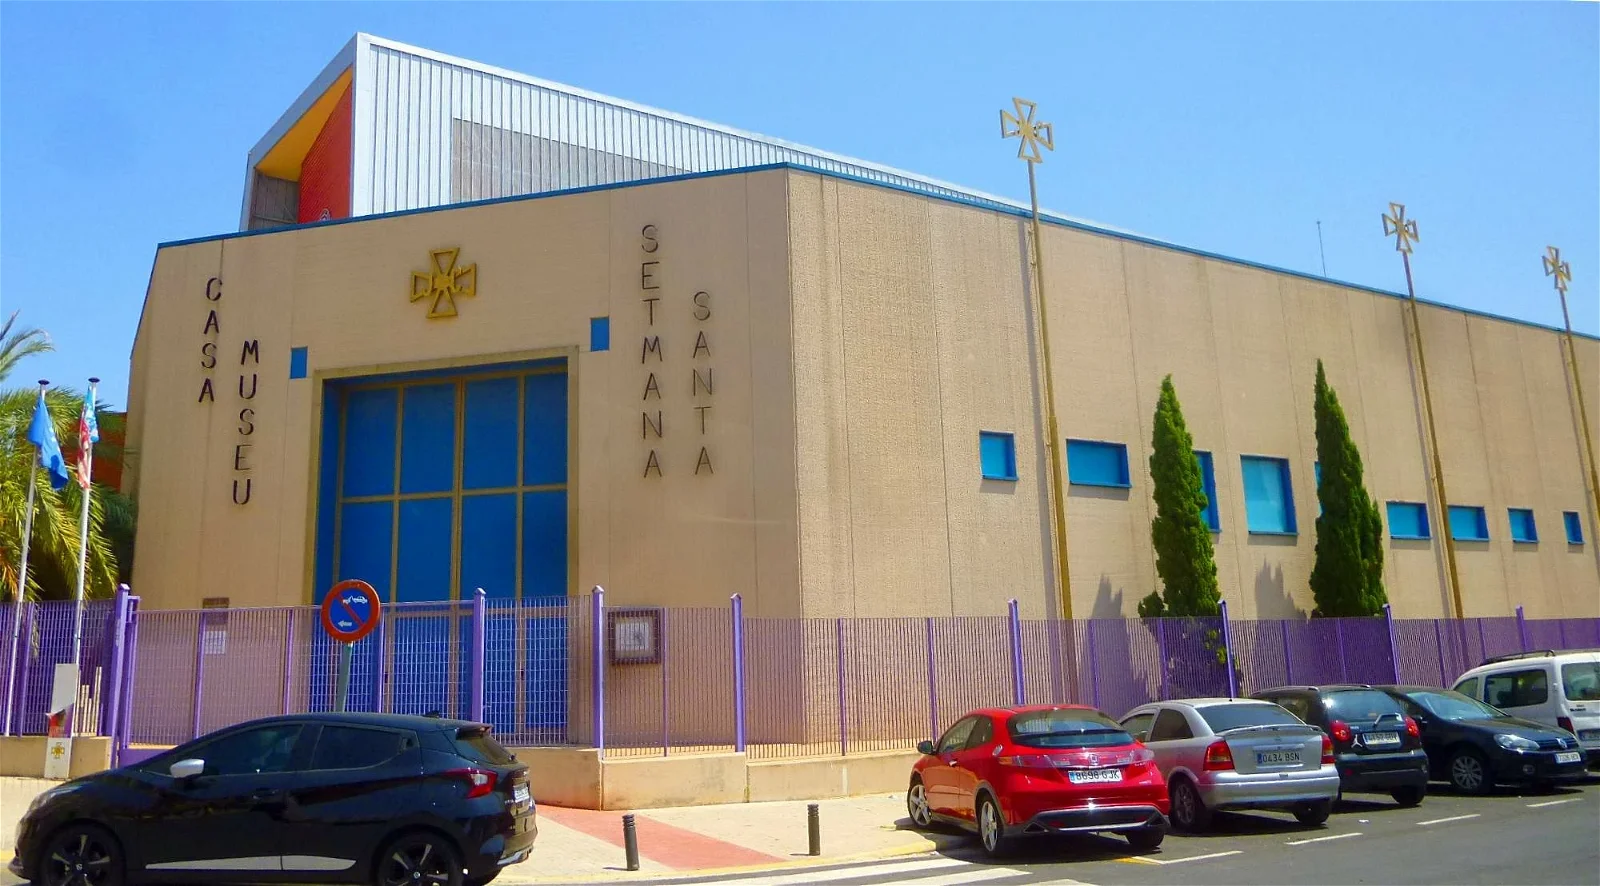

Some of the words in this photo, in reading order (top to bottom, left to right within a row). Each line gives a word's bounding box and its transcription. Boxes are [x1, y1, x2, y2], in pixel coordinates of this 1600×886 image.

[198, 277, 222, 402] CASA
[232, 339, 260, 505] MUSEU
[641, 224, 663, 478] SETMANA
[693, 291, 714, 475] SANTA
[1262, 753, 1282, 762] 0434
[1285, 752, 1300, 761] BSN
